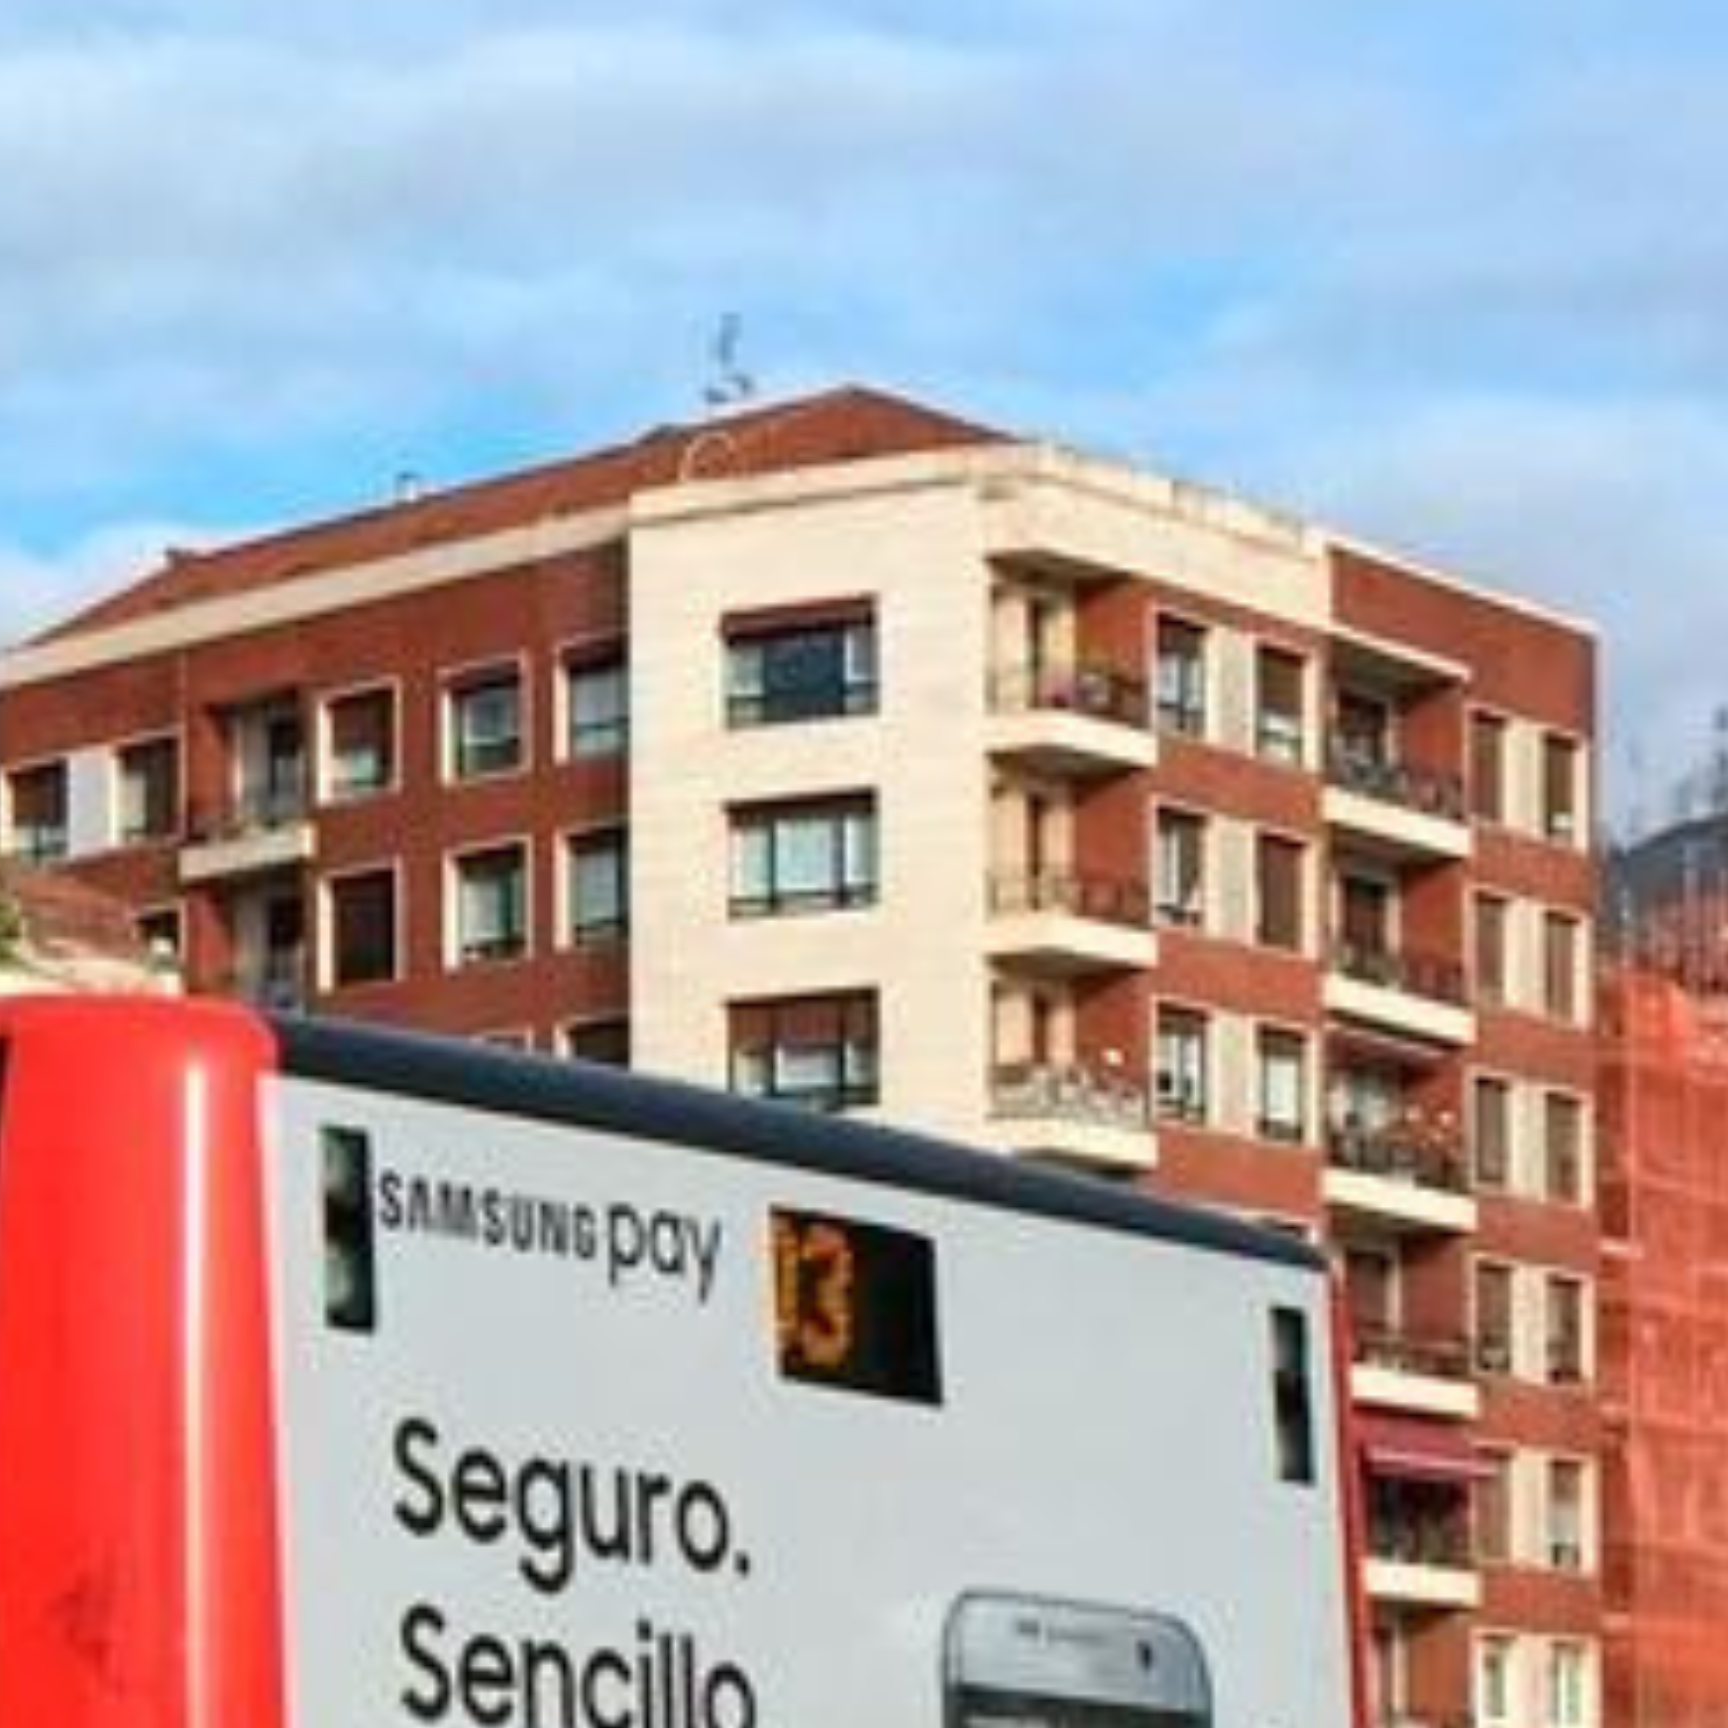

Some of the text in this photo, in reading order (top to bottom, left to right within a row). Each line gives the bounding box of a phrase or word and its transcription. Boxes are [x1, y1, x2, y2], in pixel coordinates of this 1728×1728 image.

[379, 1167, 723, 1305] SAMSUNG pay
[390, 1415, 753, 1595] Seguro.
